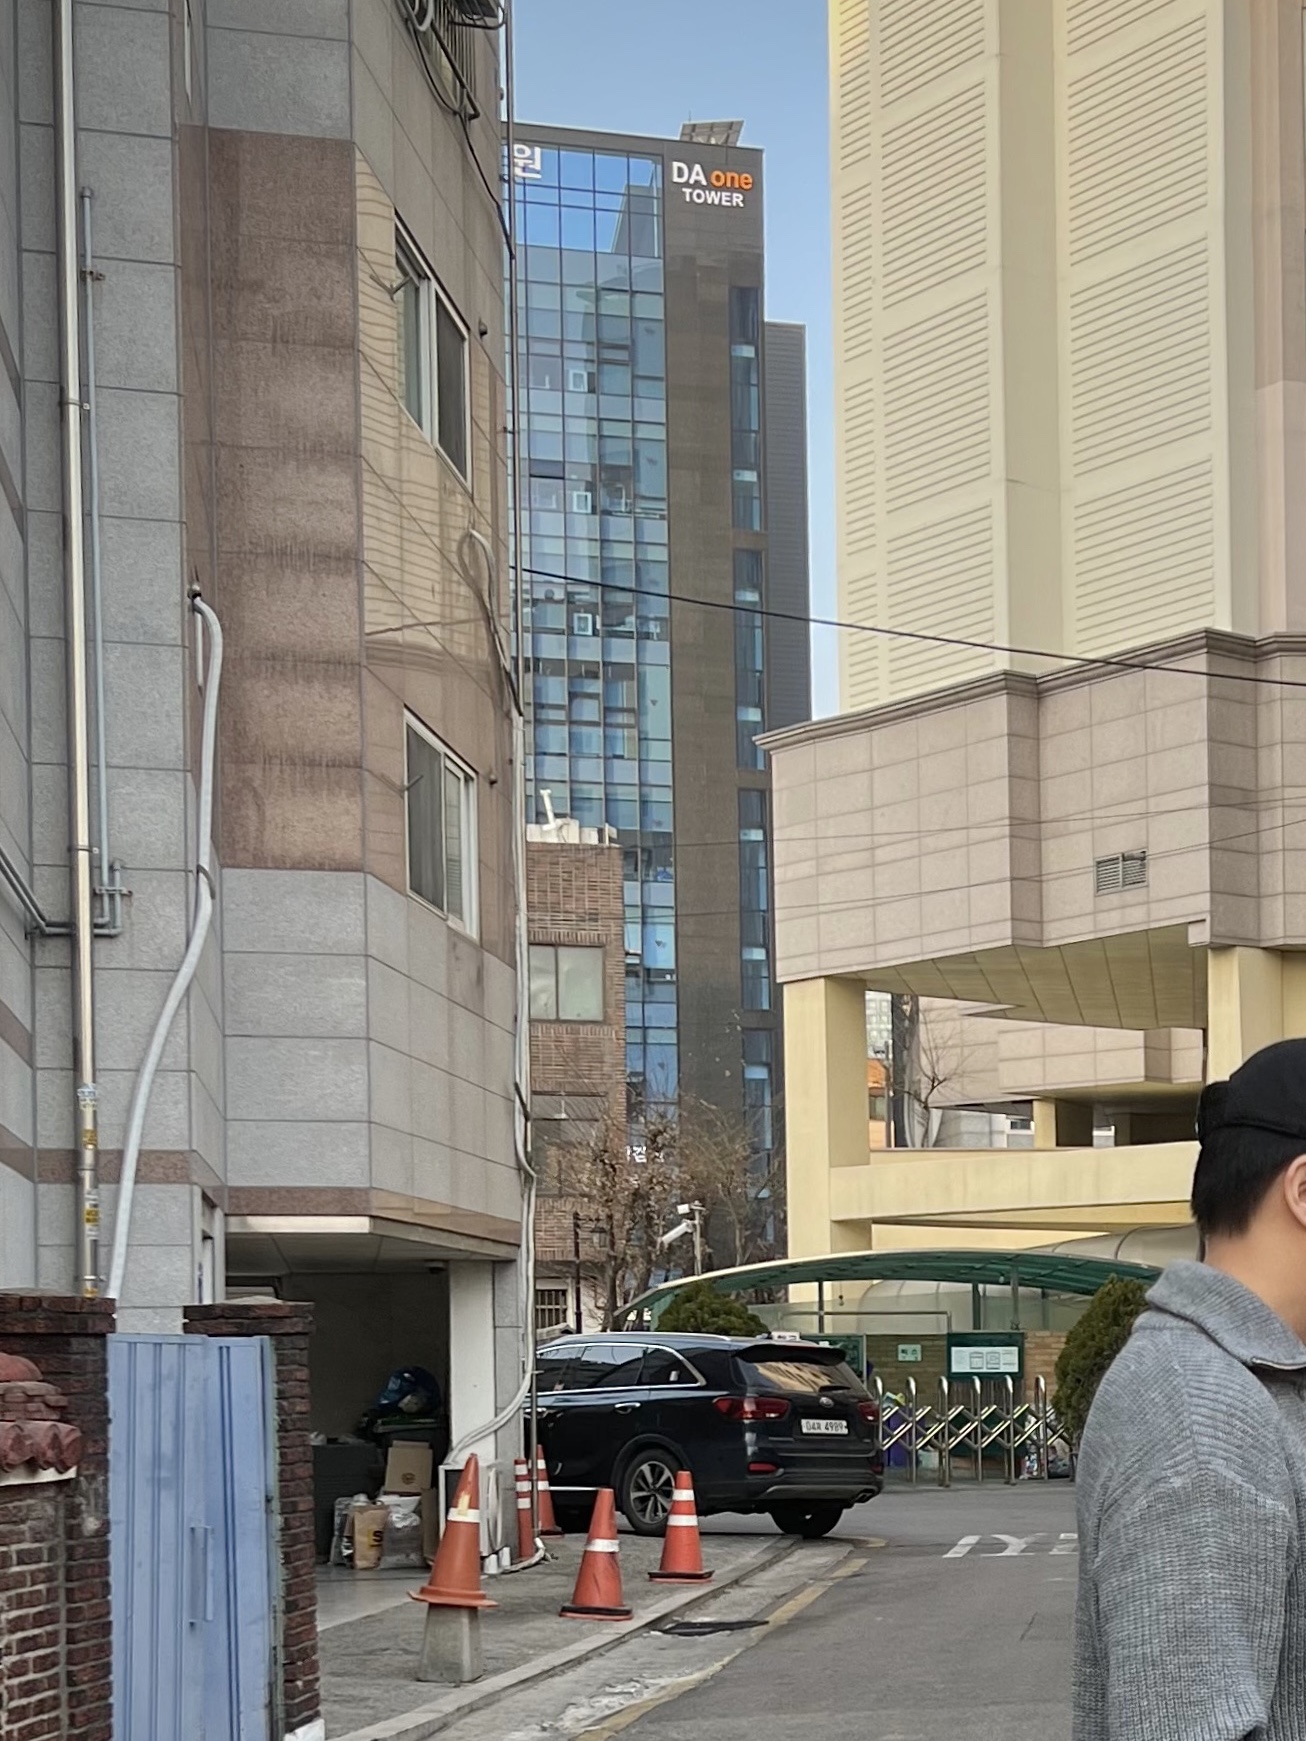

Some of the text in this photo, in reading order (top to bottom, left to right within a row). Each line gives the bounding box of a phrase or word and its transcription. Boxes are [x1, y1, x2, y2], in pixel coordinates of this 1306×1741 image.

[672, 161, 753, 190] DA one
[682, 188, 744, 208] TOWER
